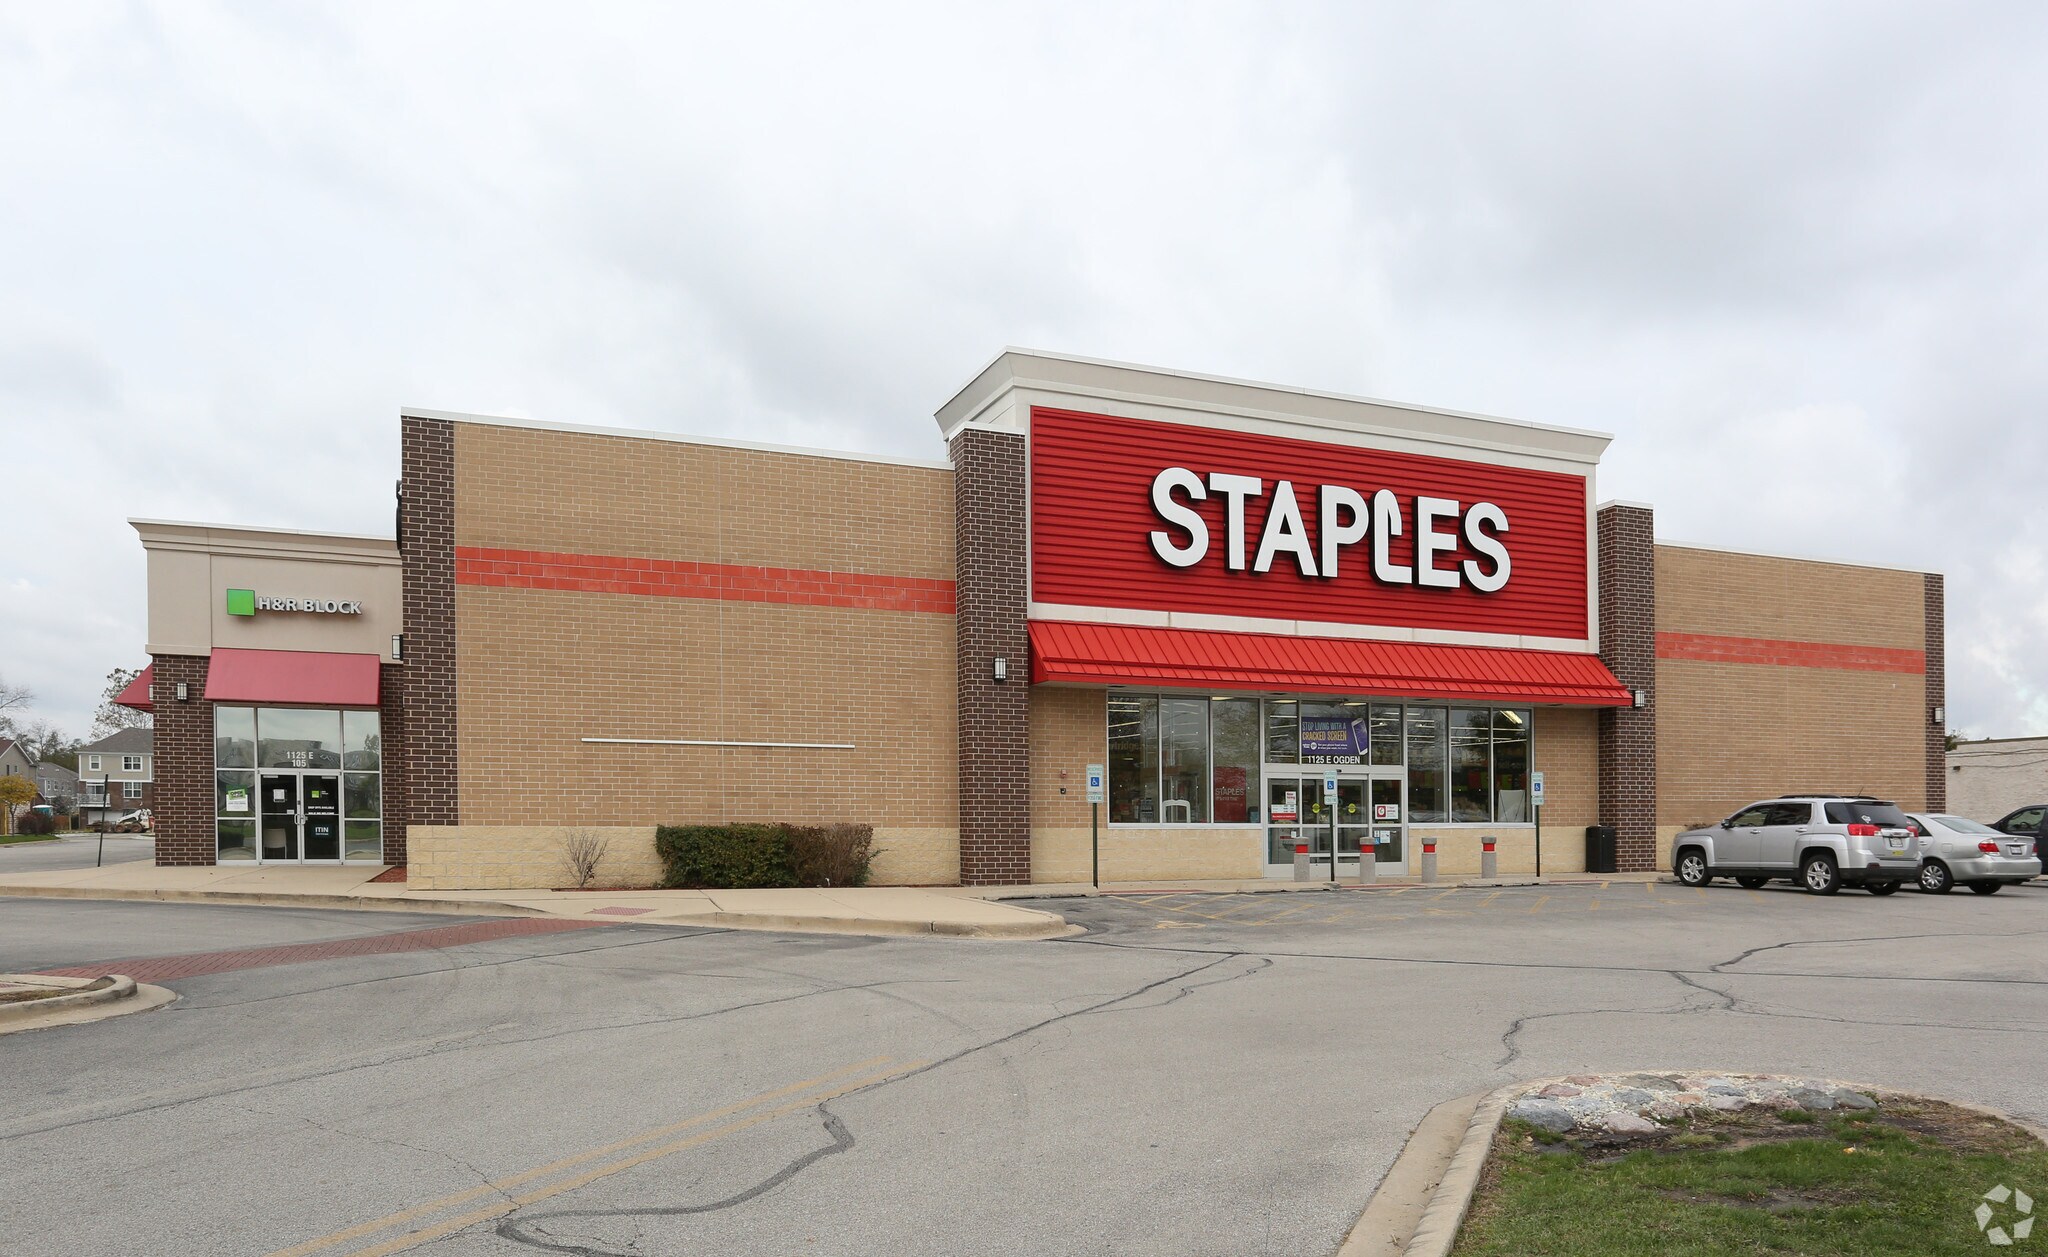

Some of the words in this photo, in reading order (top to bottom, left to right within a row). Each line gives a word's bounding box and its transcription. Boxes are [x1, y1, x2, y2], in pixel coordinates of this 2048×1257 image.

[1148, 466, 1512, 593] STAPLES
[258, 597, 298, 612] H&R
[303, 599, 362, 615] BLOCK
[1302, 722, 1314, 731] STOP
[1330, 722, 1342, 730] WITH
[1302, 731, 1326, 741] CRACKED
[1327, 730, 1347, 741] SCREEN
[287, 751, 306, 759] 1125
[309, 752, 314, 760] E
[1308, 756, 1325, 764] 1125
[1327, 756, 1331, 764] E
[1333, 756, 1360, 764] OGDEN
[1215, 787, 1245, 796] STAPLES
